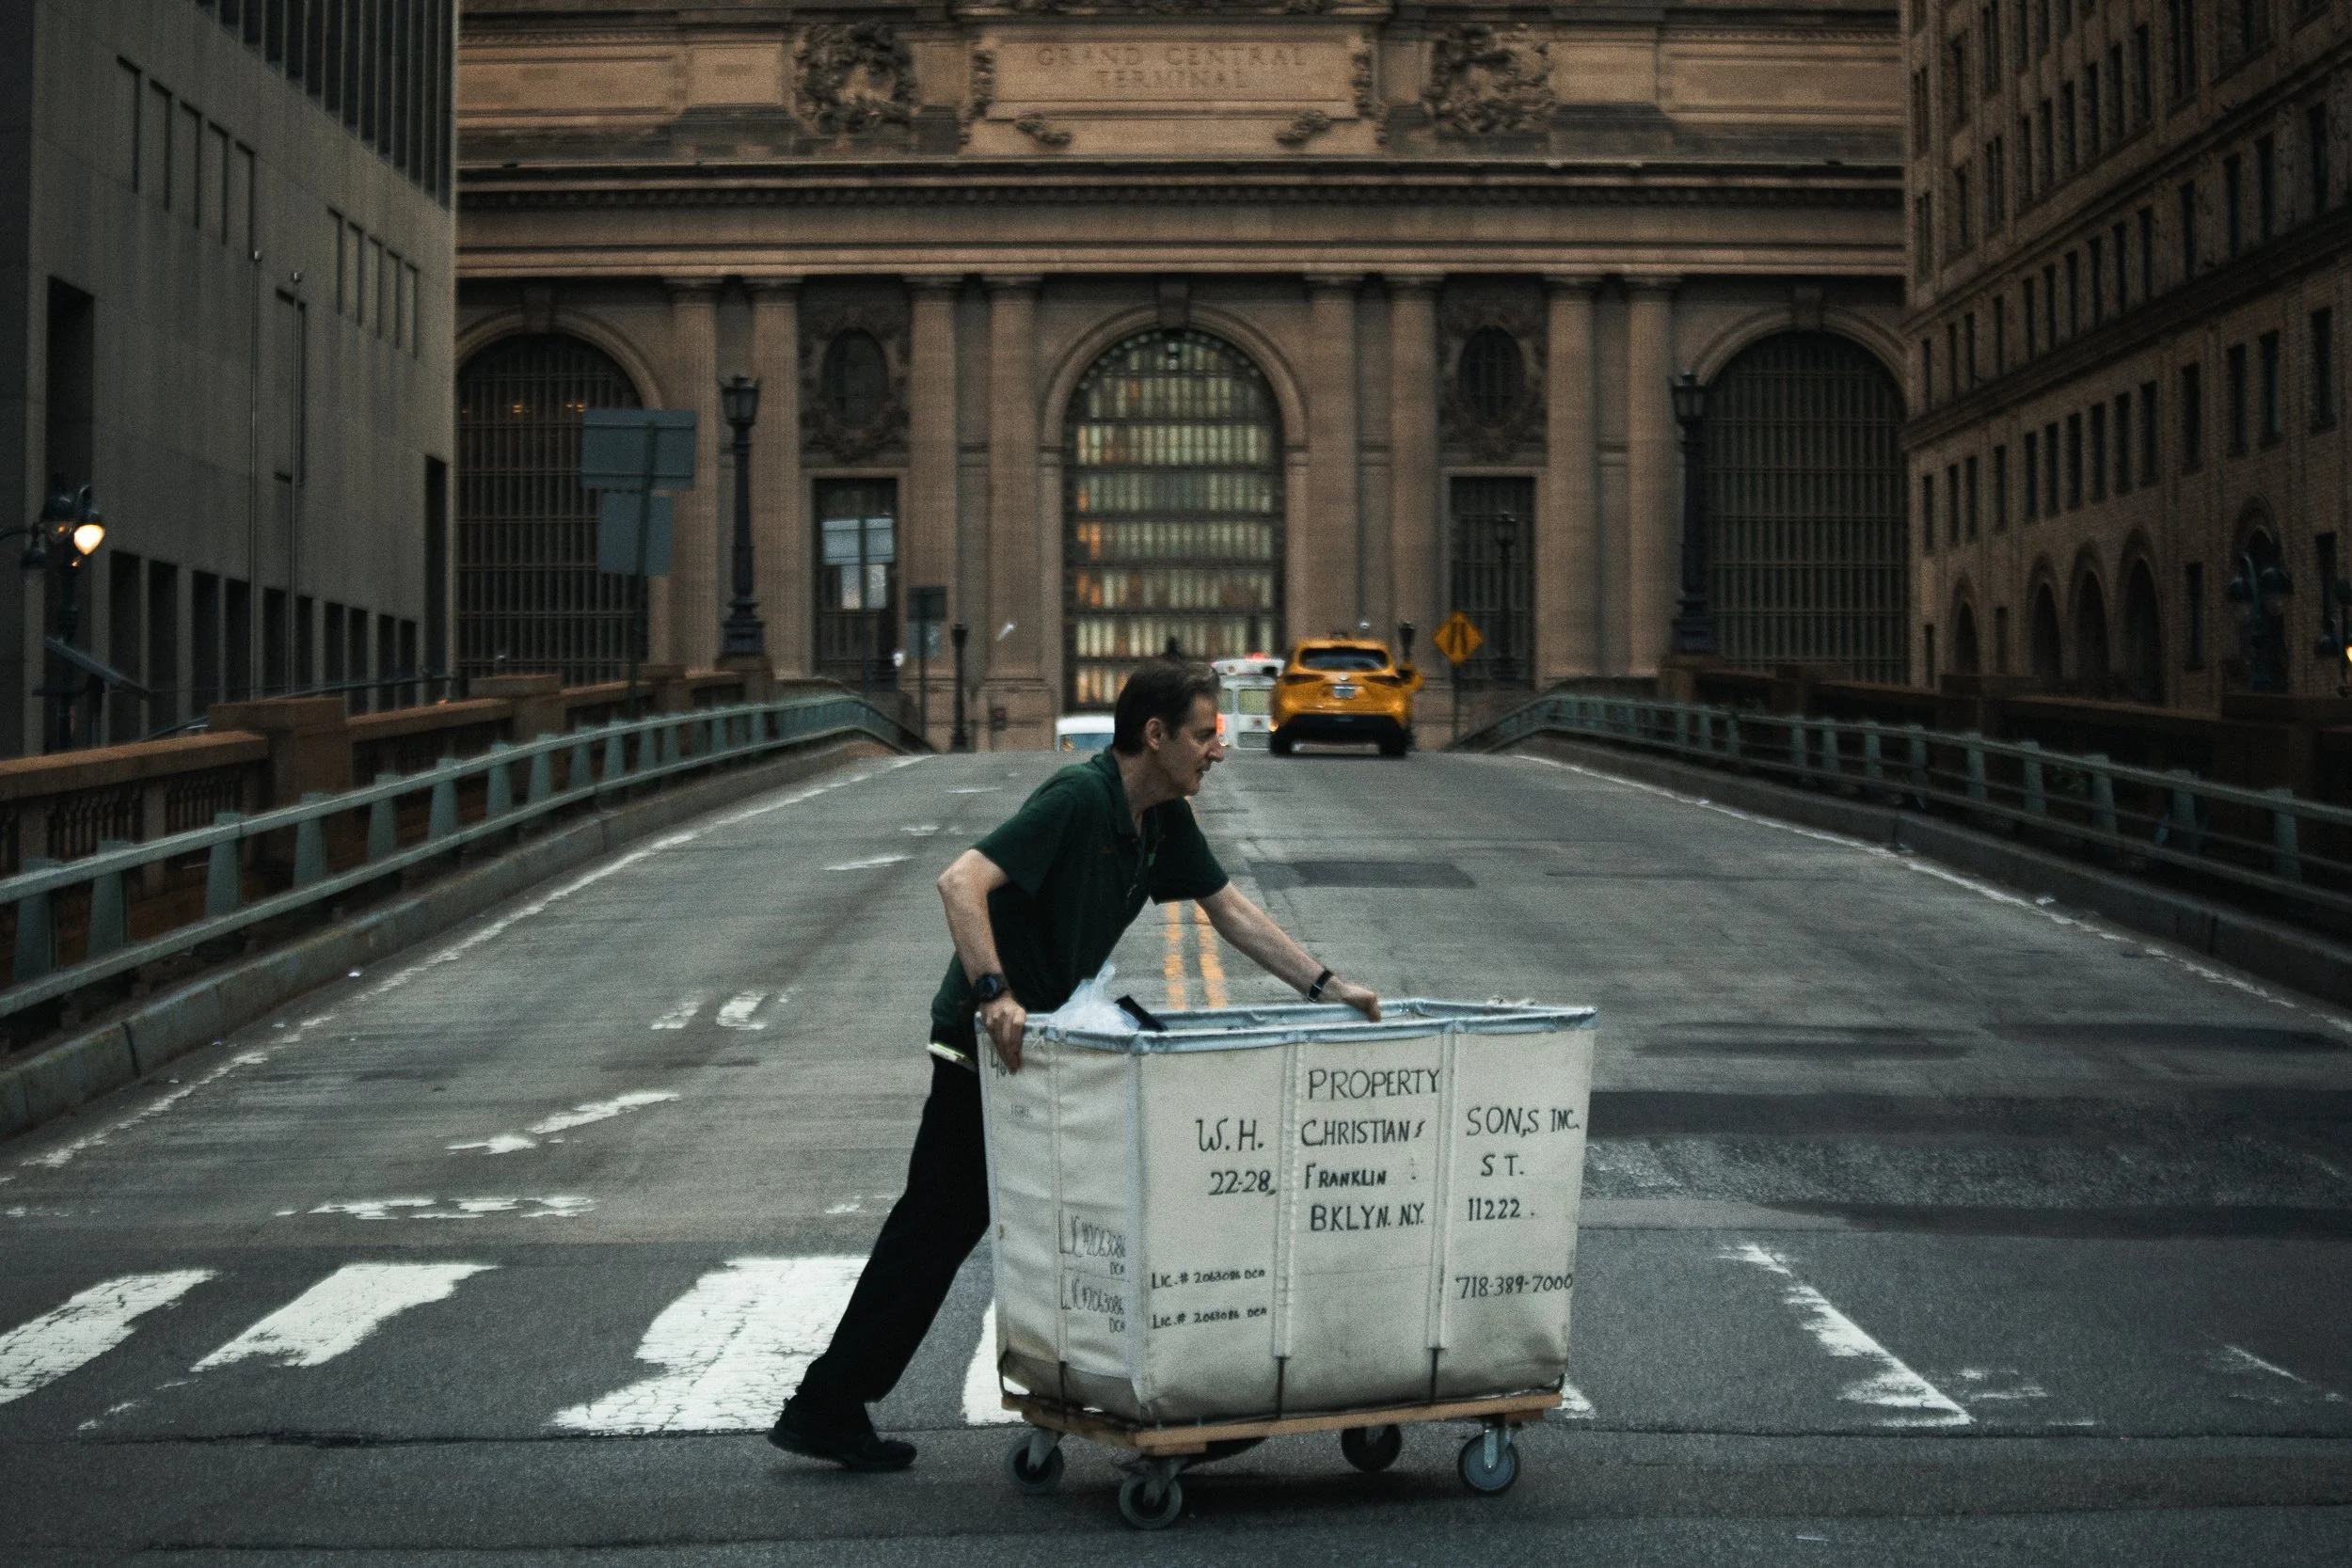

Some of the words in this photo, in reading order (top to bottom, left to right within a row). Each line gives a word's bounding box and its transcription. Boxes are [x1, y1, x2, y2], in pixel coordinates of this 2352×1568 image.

[1037, 47, 1142, 67] GRAND
[1164, 47, 1307, 67] CENTRAL
[1095, 70, 1248, 89] TERMINAL
[1309, 1069, 1440, 1100] PROPERTY
[1244, 1269, 1265, 1279] DCA
[1455, 1273, 1573, 1299] 718-389-7000
[1247, 1307, 1267, 1318] DCA
